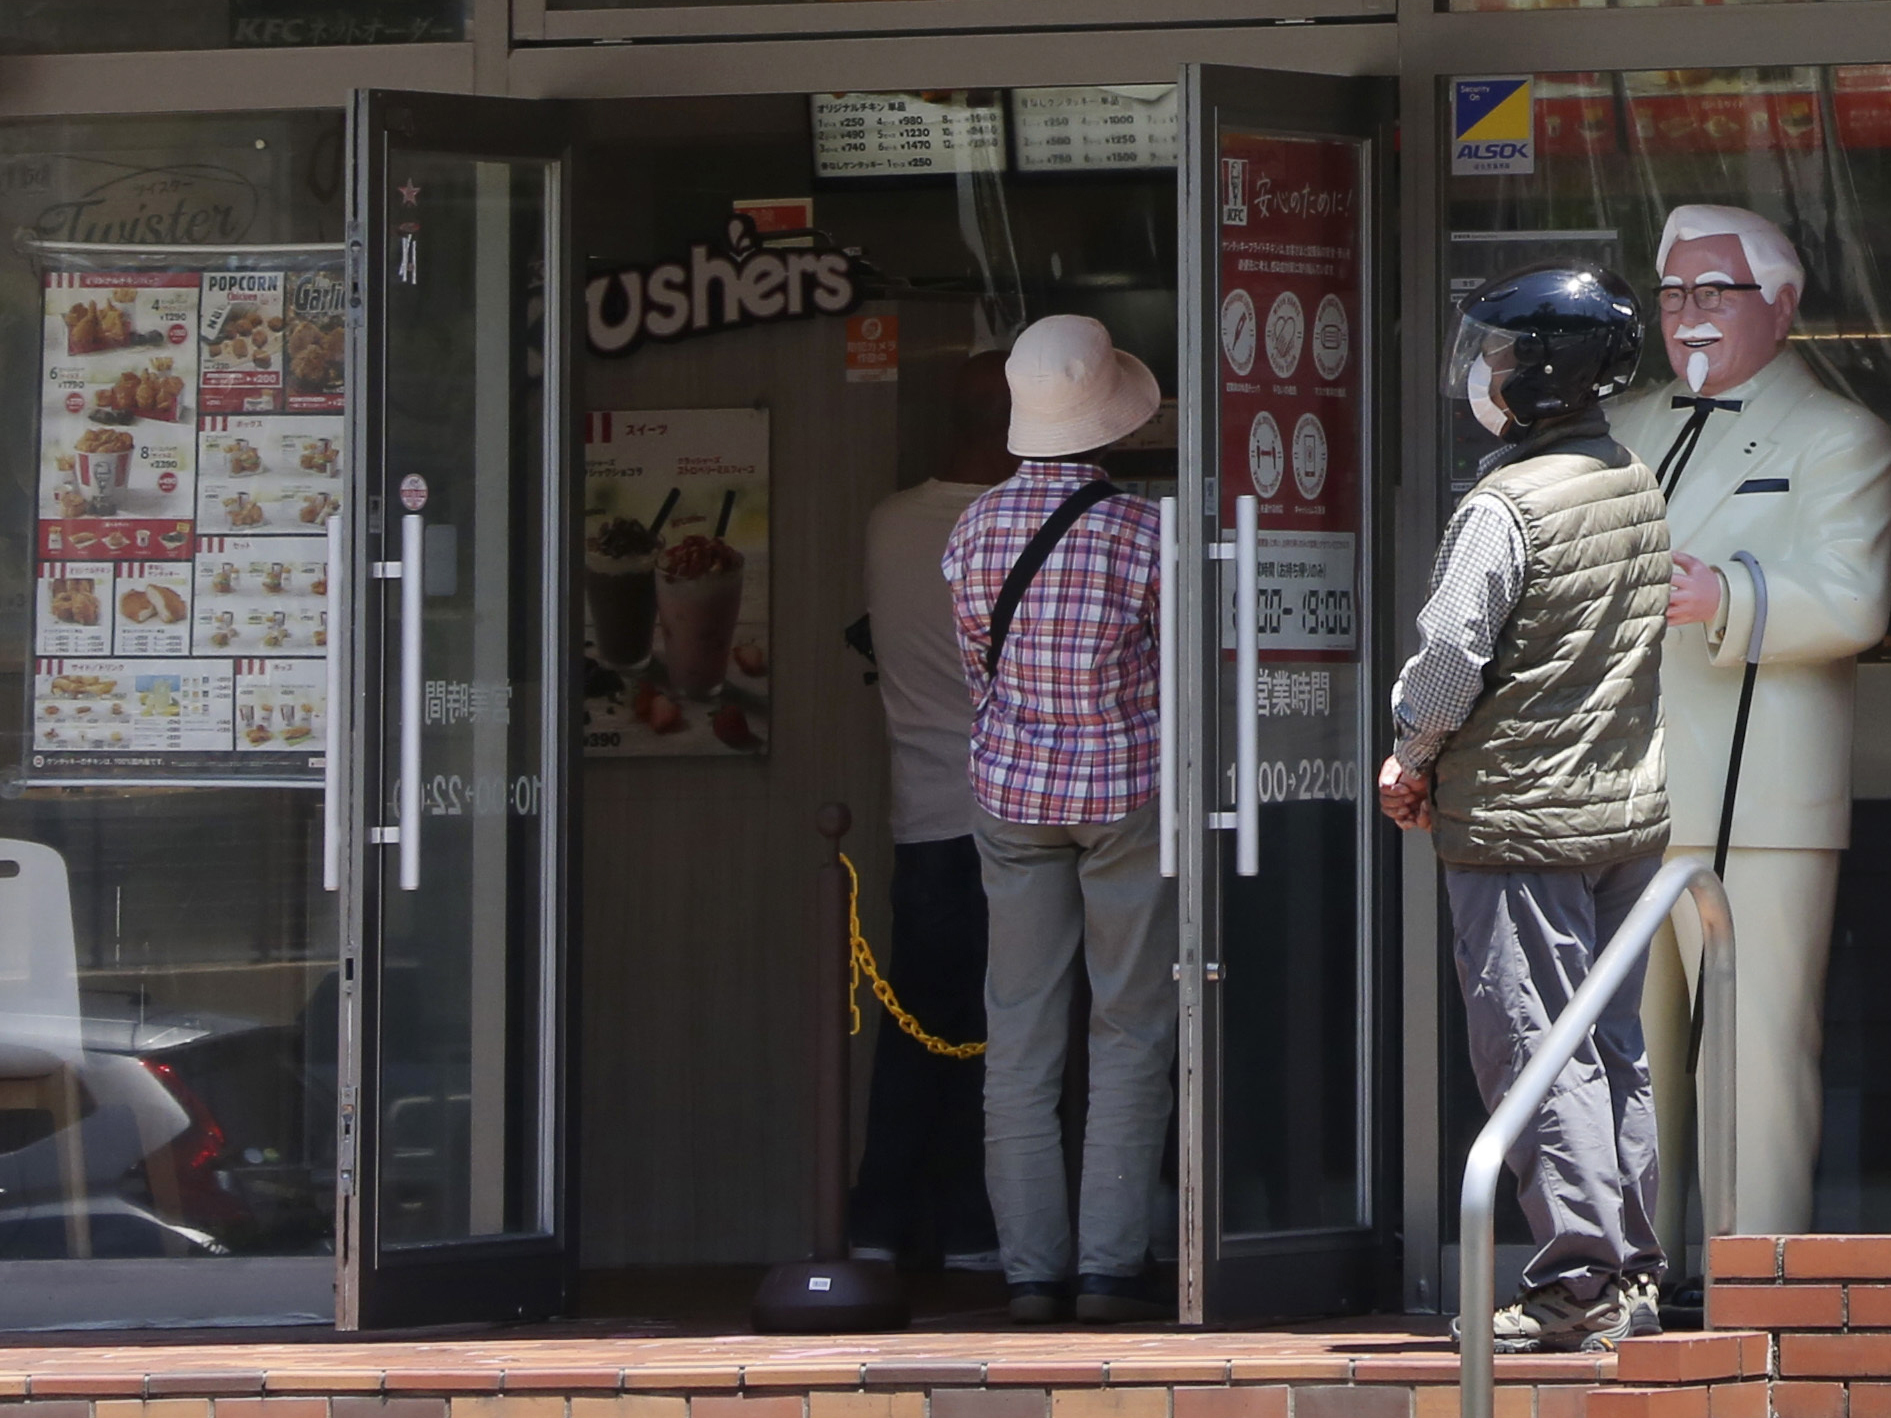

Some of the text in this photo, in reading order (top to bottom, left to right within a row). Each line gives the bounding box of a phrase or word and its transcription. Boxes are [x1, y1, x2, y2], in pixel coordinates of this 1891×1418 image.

[1460, 85, 1490, 93] Security
[1469, 93, 1480, 101] On
[817, 101, 906, 113] オリジナルチキン 単品
[840, 117, 864, 127] ¥250
[899, 116, 923, 125] ¥980
[900, 128, 930, 138] ¥1230
[901, 140, 931, 150] ¥1470
[1457, 143, 1529, 160] ALSOK
[908, 157, 932, 167] ¥250
[209, 275, 278, 291] POPCORN
[294, 275, 346, 313] Garli
[626, 424, 668, 436] スイーツ
[140, 446, 150, 460] 8
[1257, 667, 1330, 717] 営業時間
